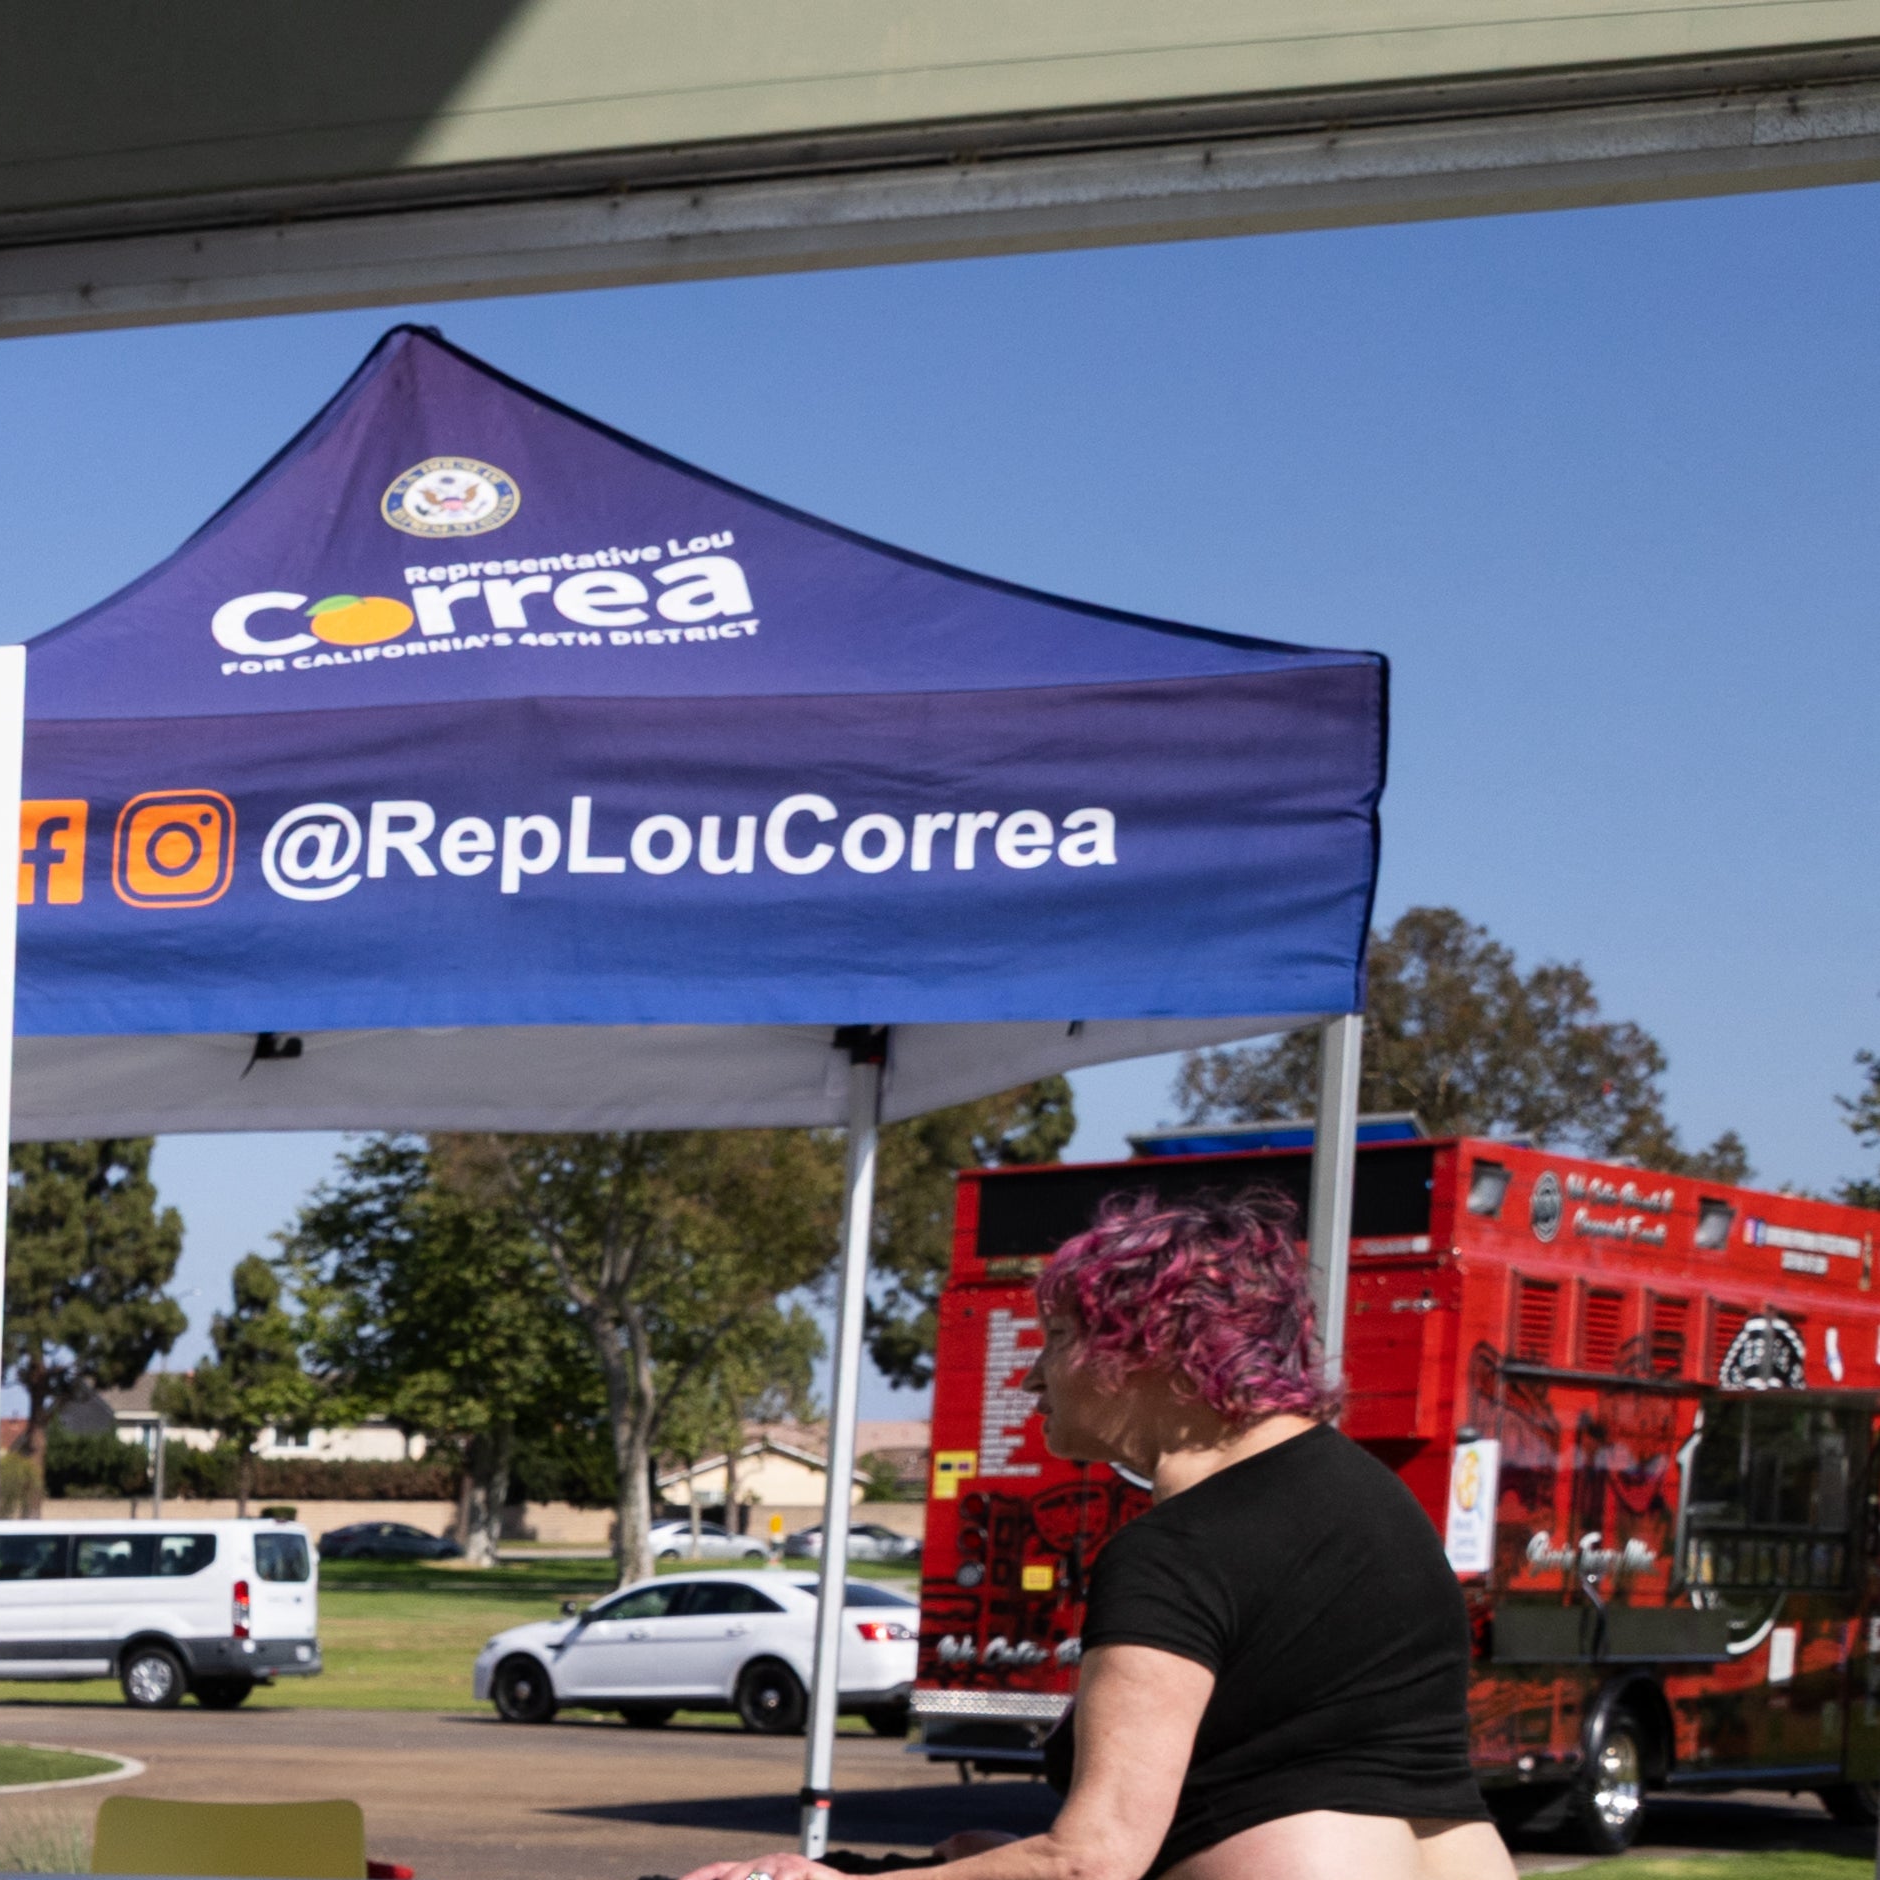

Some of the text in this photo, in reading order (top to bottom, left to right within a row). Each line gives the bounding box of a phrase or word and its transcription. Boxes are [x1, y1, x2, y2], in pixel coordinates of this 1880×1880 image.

[404, 530, 735, 586] Representative Lou
[220, 618, 762, 677] FOR CALIFORNIA'S 46TH DISTRICT
[260, 794, 1118, 903] @RepLouCorrea
